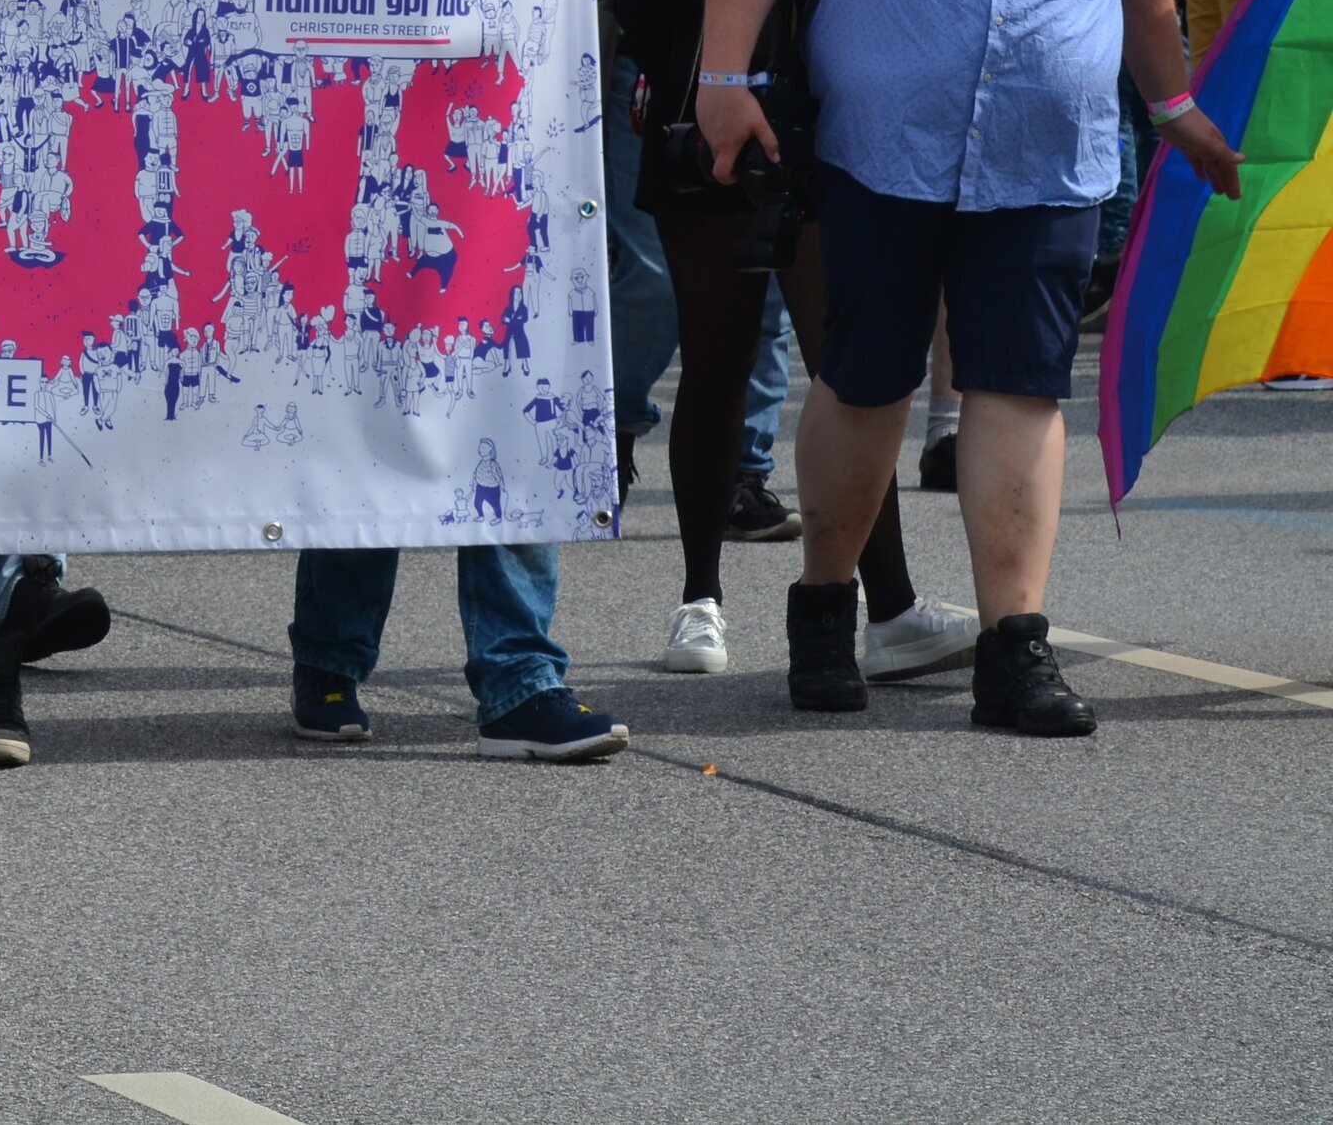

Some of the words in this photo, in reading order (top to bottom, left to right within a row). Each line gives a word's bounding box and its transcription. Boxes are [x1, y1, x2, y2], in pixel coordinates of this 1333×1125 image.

[290, 21, 379, 35] CHRISTOPHER
[382, 23, 428, 37] STREET
[431, 24, 451, 36] DAY
